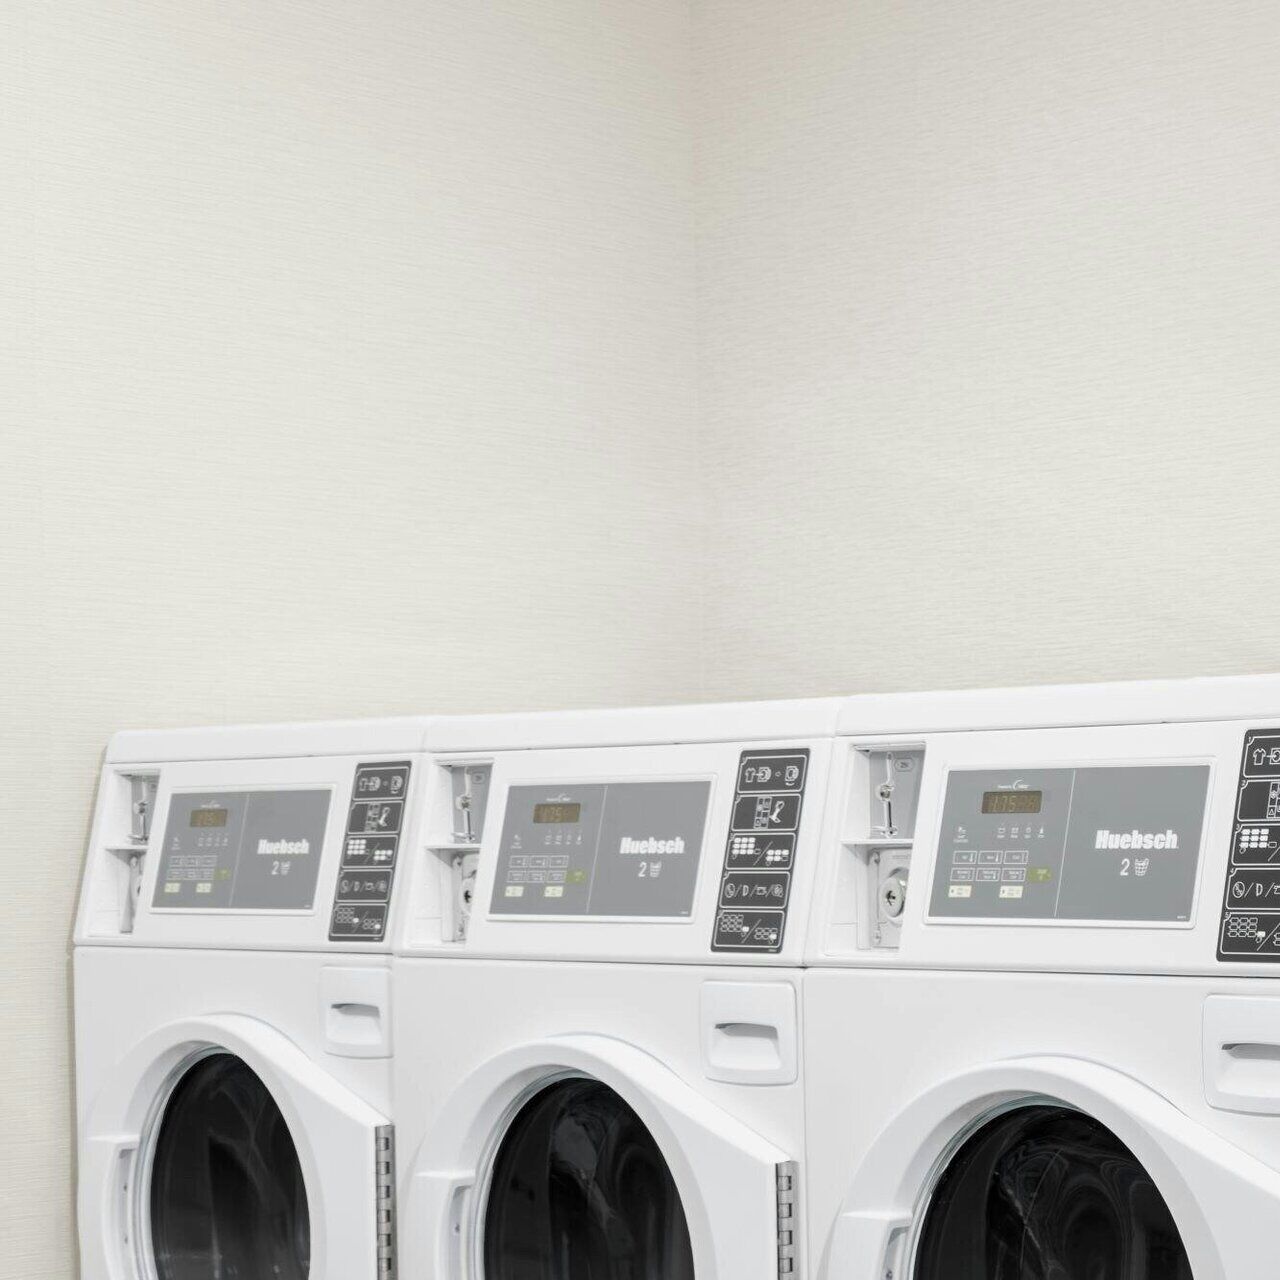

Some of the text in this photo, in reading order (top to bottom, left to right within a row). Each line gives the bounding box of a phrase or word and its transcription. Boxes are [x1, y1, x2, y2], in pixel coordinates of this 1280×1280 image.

[619, 836, 685, 854] Huebsch
[1095, 829, 1178, 849] Huebsch
[271, 860, 280, 875] 2
[638, 861, 647, 877] 2
[1120, 858, 1130, 876] 2
